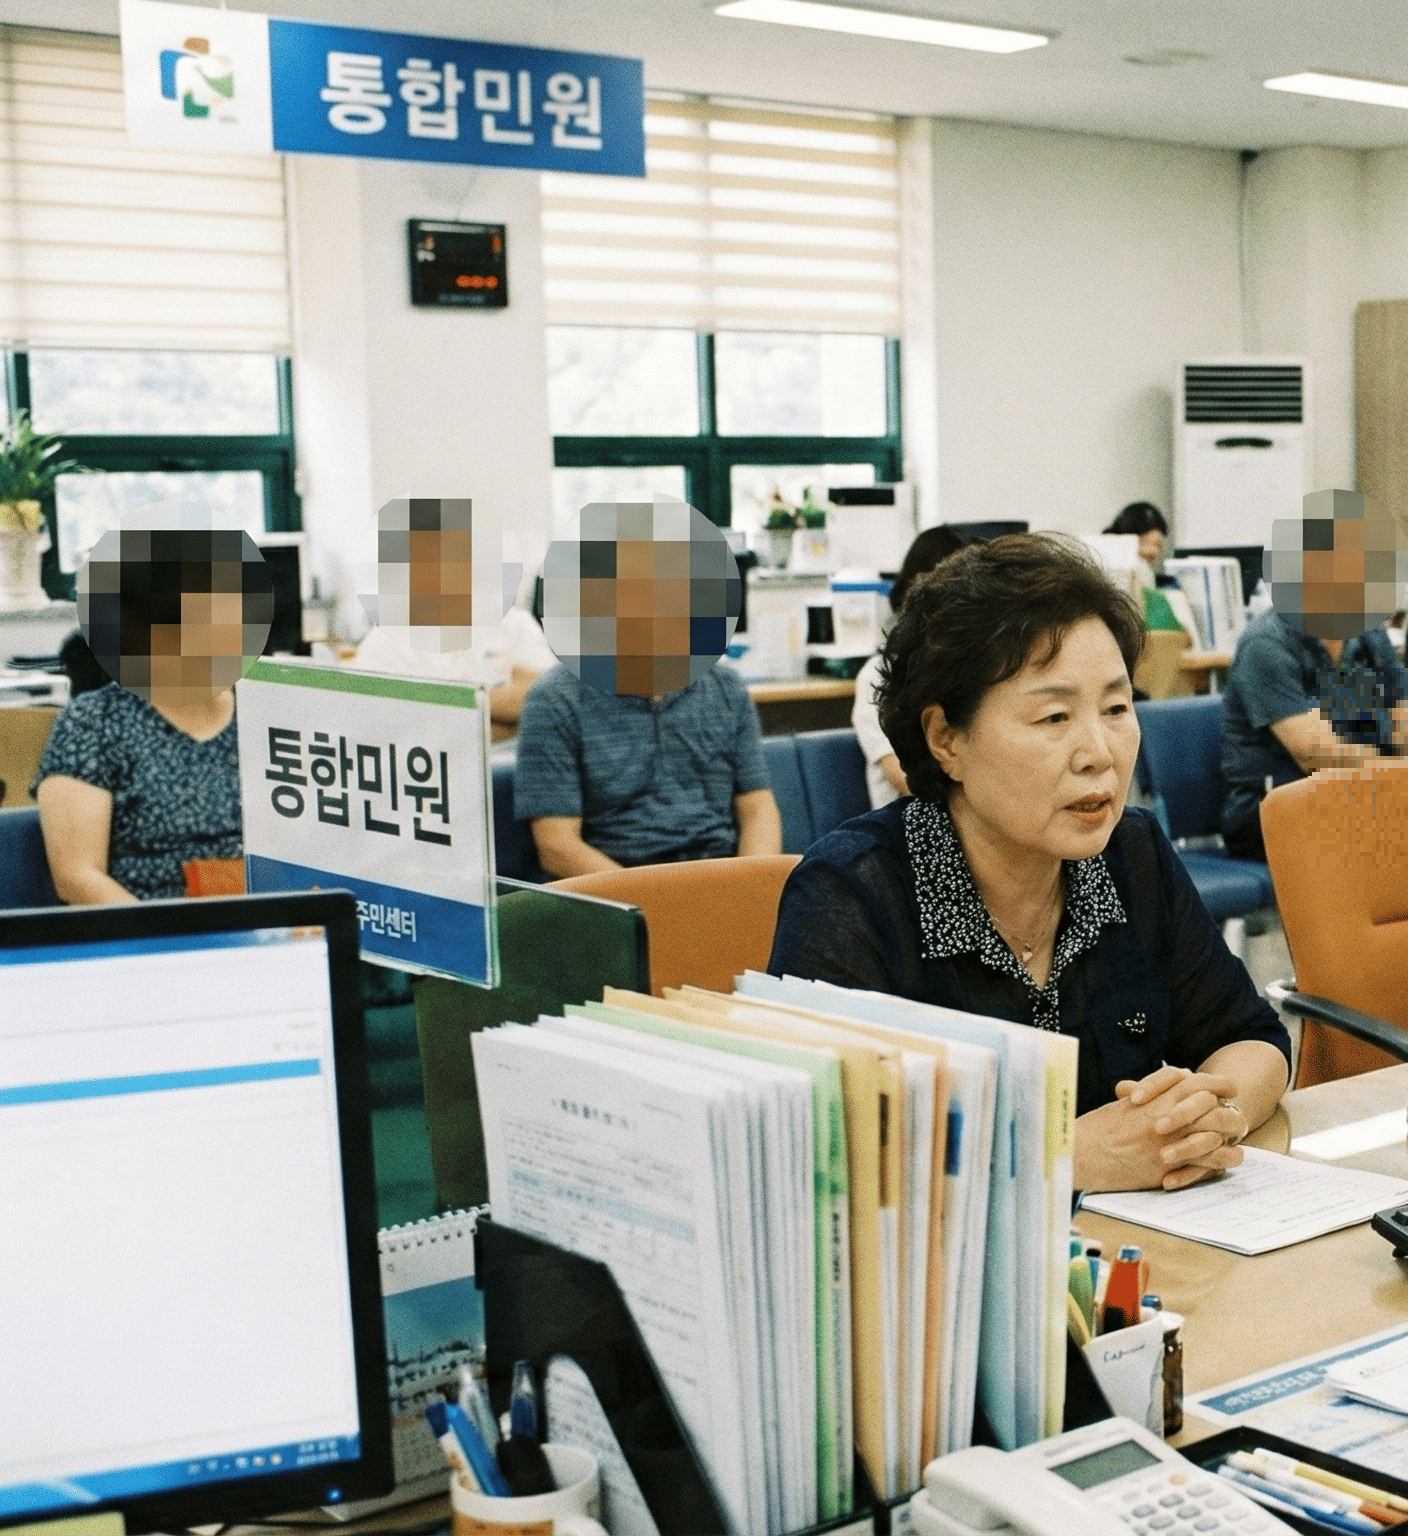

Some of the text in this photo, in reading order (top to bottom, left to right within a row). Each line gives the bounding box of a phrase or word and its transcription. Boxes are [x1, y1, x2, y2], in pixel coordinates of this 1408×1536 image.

[320, 51, 603, 151] 통합민원
[265, 727, 452, 847] 통합민원
[355, 900, 417, 943] 주민센터
